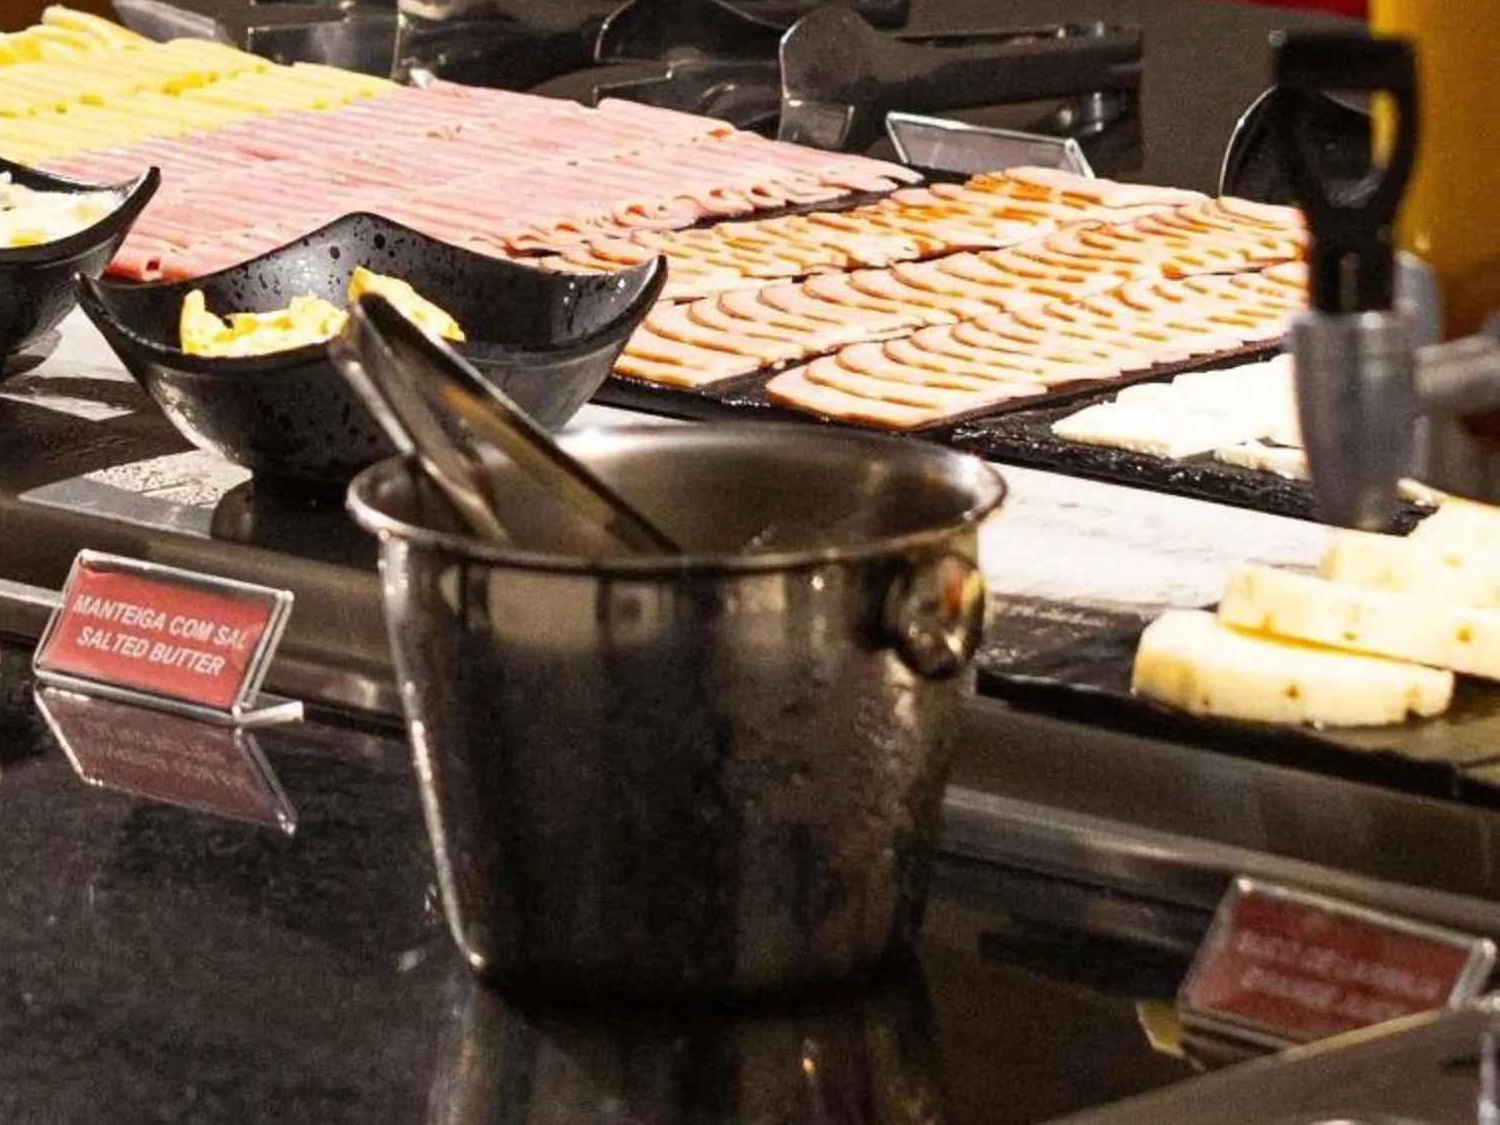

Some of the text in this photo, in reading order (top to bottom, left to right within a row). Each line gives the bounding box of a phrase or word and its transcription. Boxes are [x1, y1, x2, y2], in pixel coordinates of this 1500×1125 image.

[73, 595, 249, 648] MANTEIGA COM SAL
[77, 627, 225, 675] SALTED BUTTER
